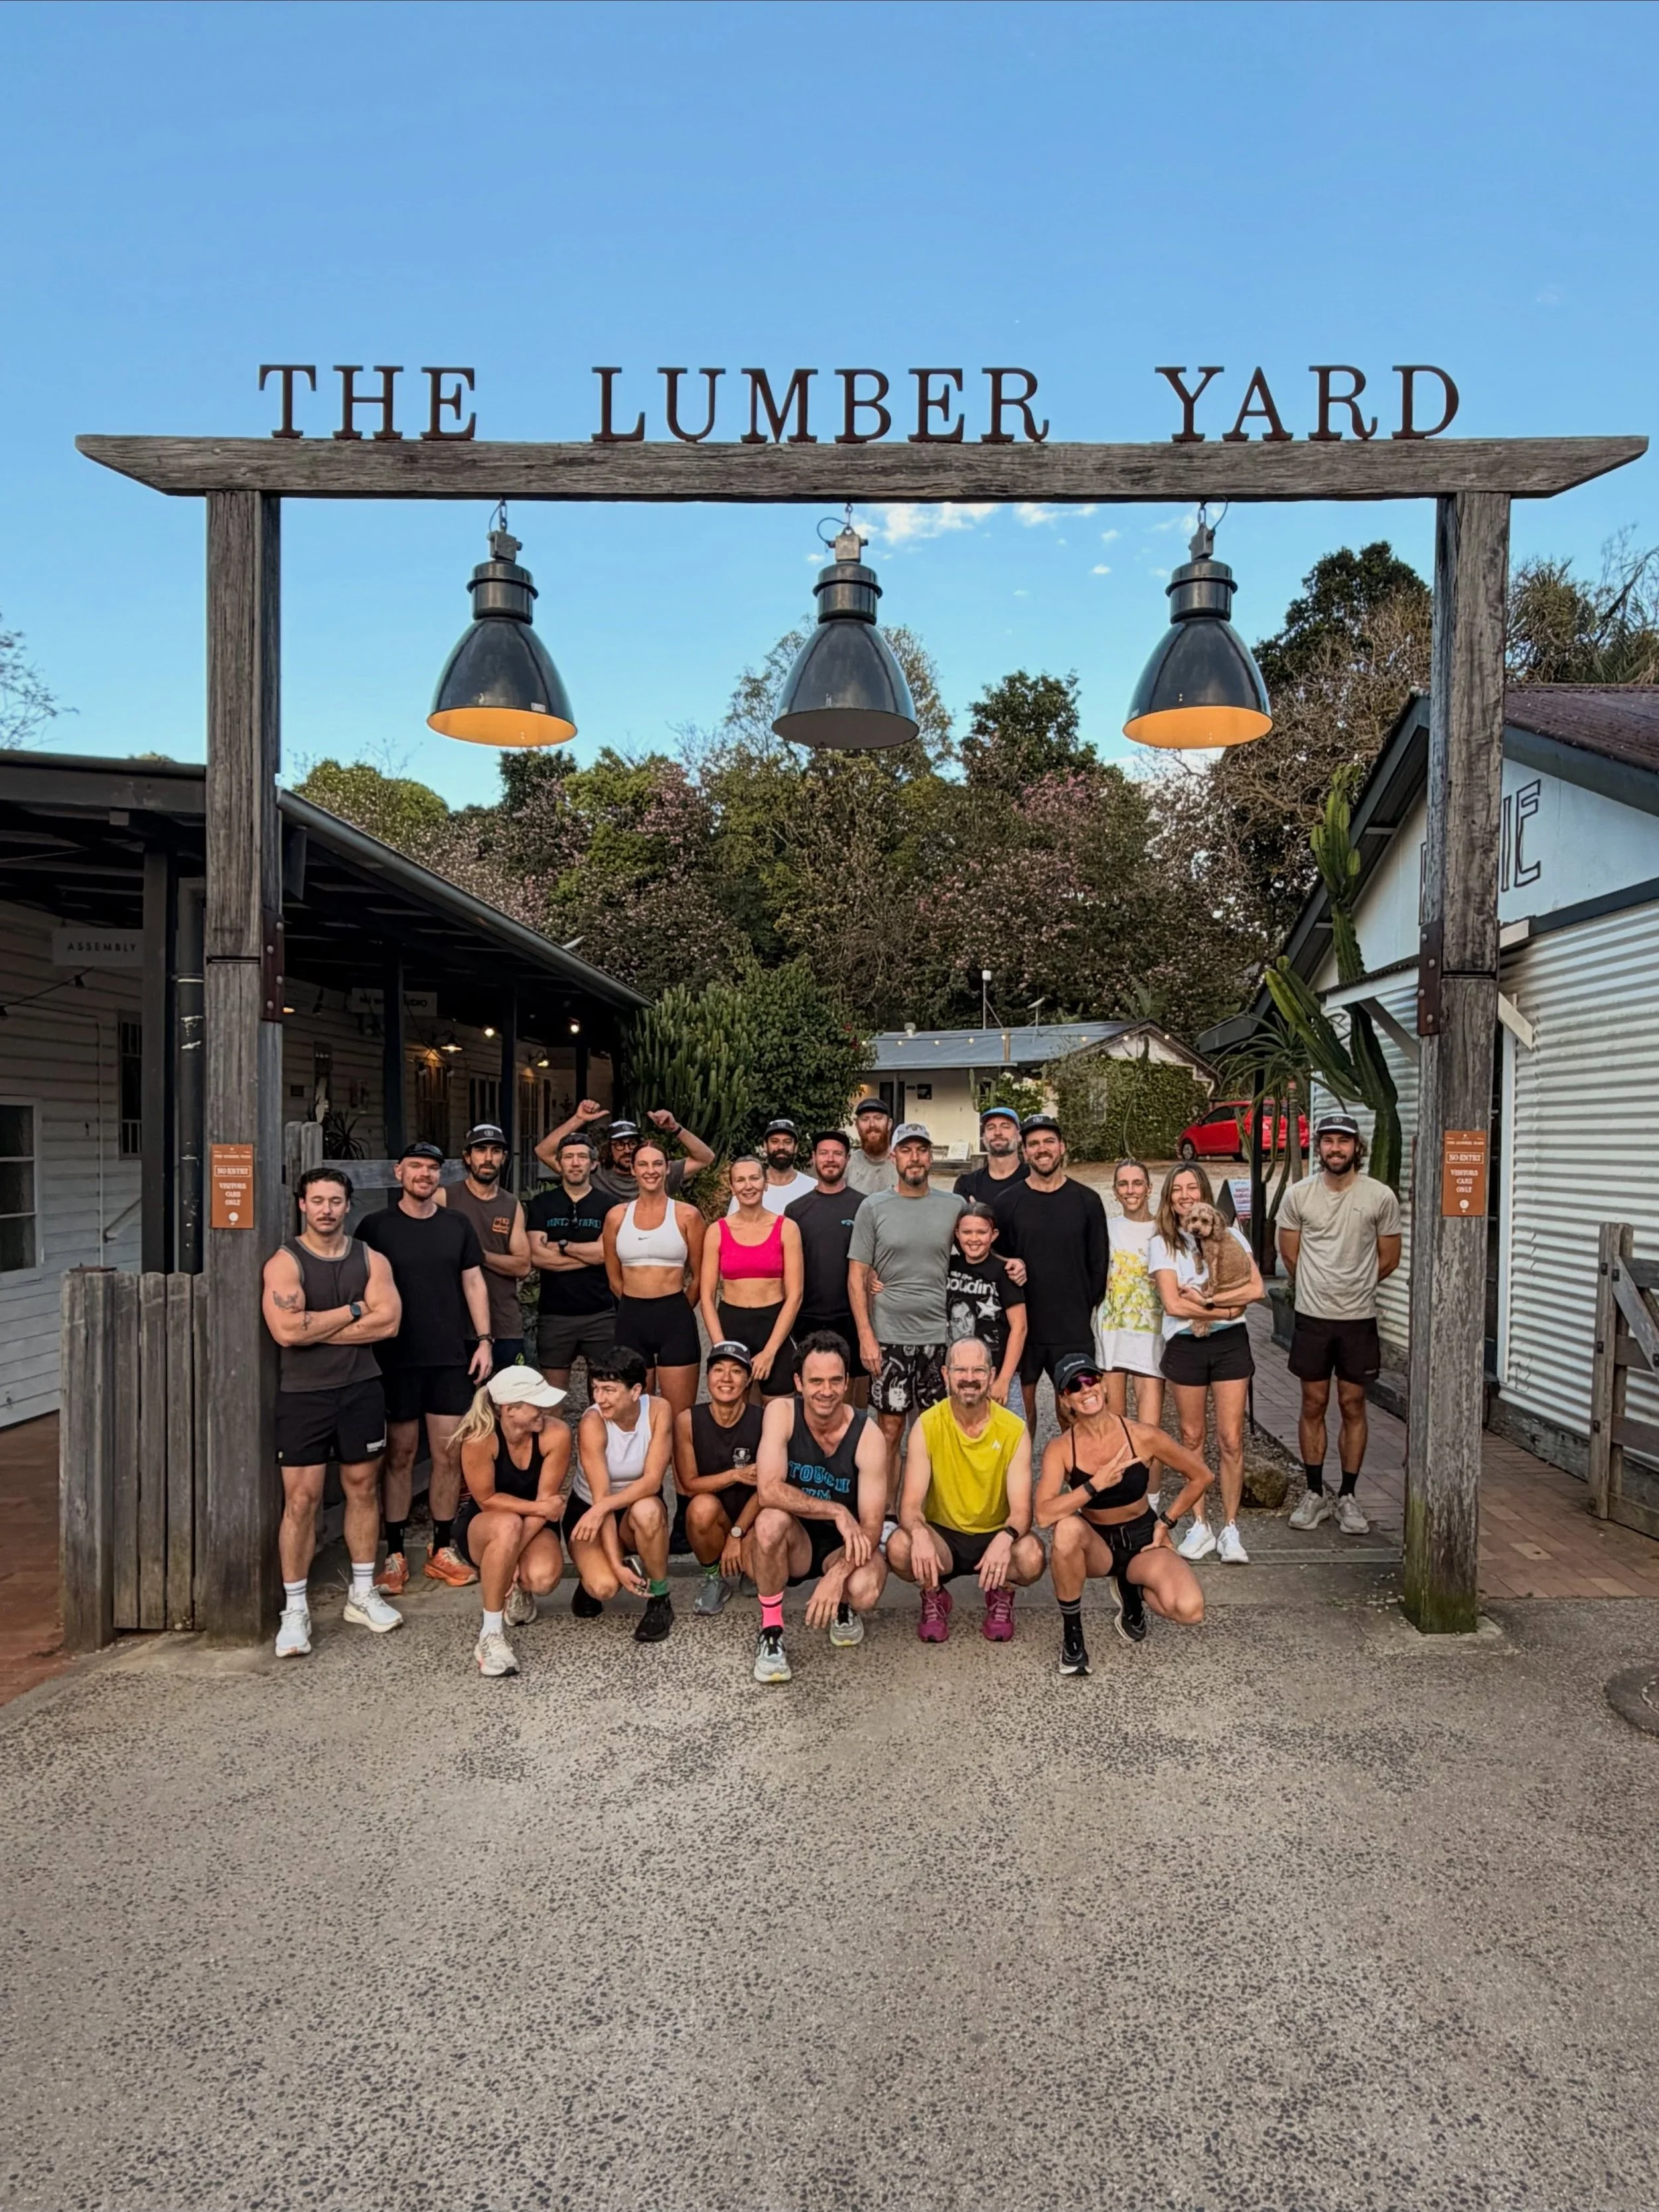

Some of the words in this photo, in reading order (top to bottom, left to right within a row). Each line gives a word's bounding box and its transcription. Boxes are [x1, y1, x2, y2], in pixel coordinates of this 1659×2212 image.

[259, 364, 476, 441] THE
[591, 366, 1049, 443] LUMBER
[1155, 365, 1459, 442] YARD
[67, 942, 137, 952] ASSEMBLY
